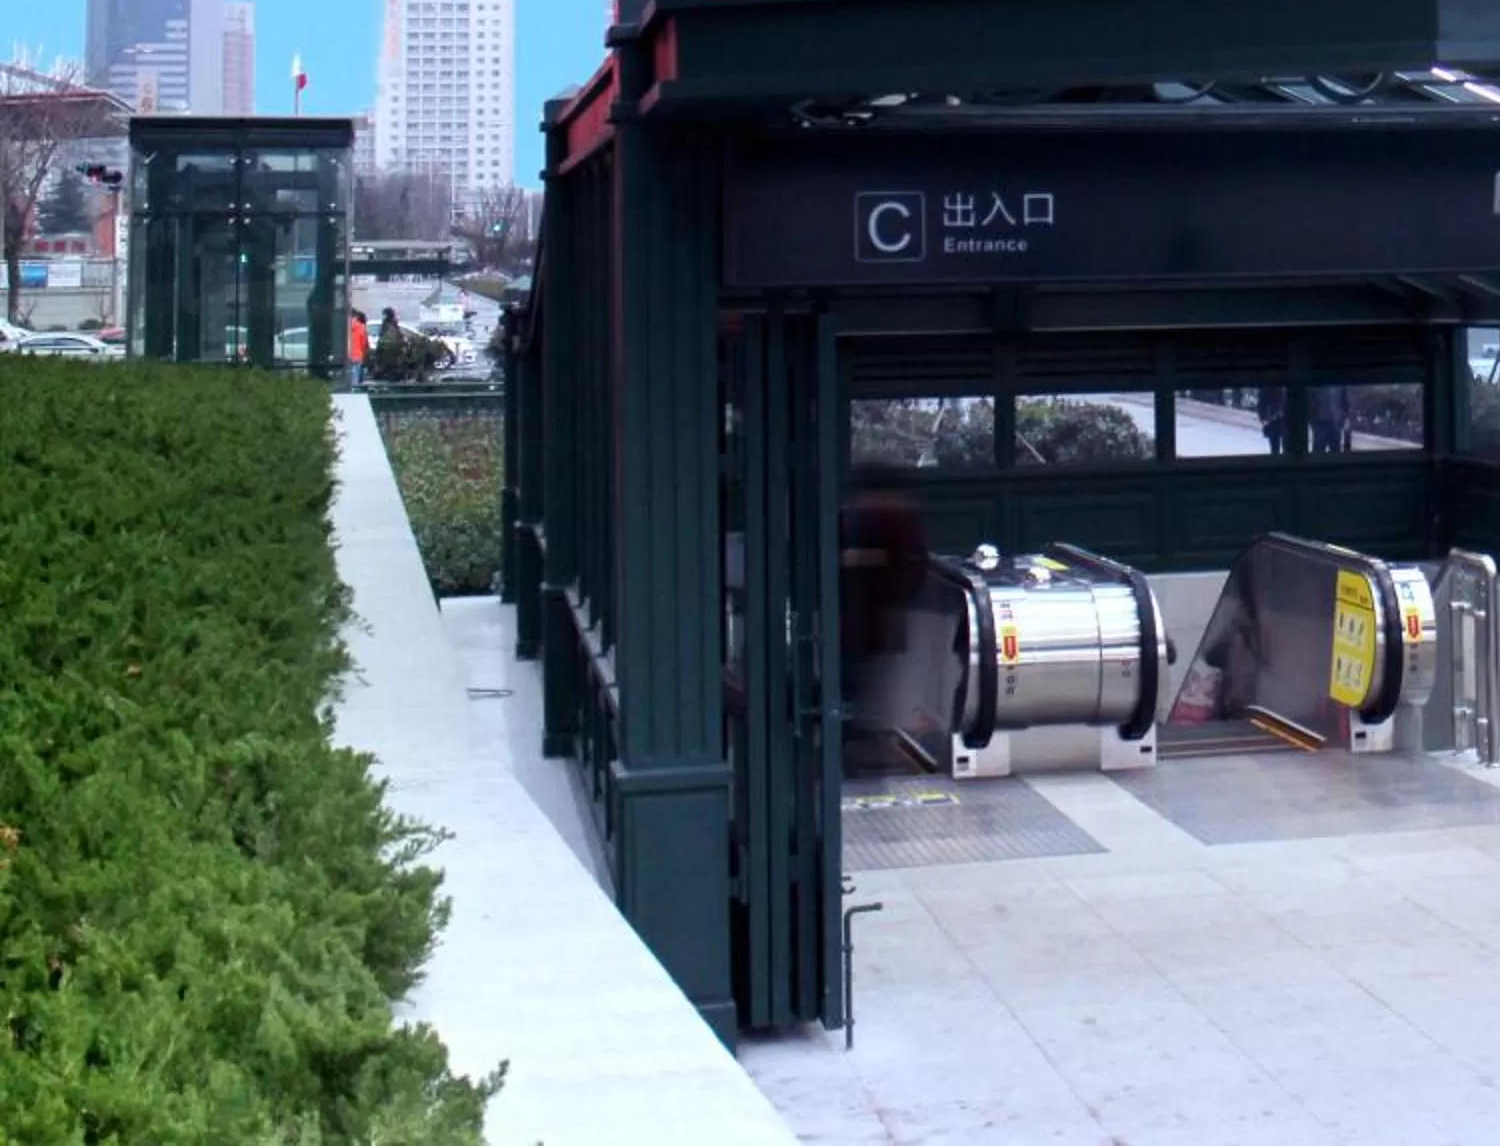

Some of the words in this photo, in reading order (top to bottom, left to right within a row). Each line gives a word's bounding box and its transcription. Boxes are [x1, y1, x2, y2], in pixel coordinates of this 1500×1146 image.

[943, 192, 1054, 226] 出入口
[868, 201, 911, 252] C
[943, 237, 1028, 253] Entrance
